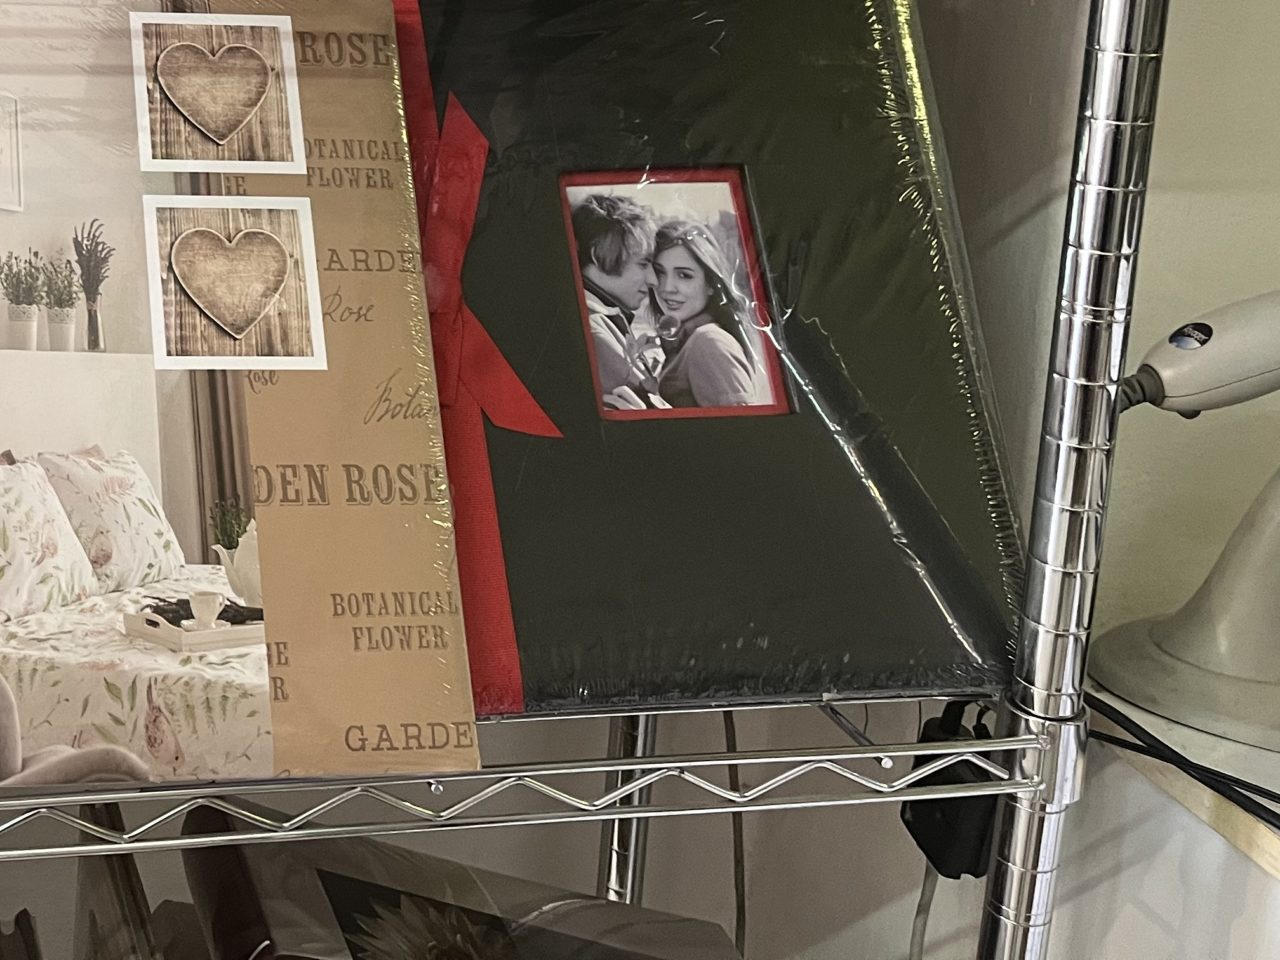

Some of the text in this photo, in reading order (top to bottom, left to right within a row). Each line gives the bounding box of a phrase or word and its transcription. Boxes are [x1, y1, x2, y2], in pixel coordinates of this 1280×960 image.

[296, 30, 393, 67] ROSE
[341, 463, 447, 507] ROSE
[330, 591, 458, 618] BOTANICAL
[352, 624, 449, 652] FLOWER
[344, 721, 474, 752] GARDE
